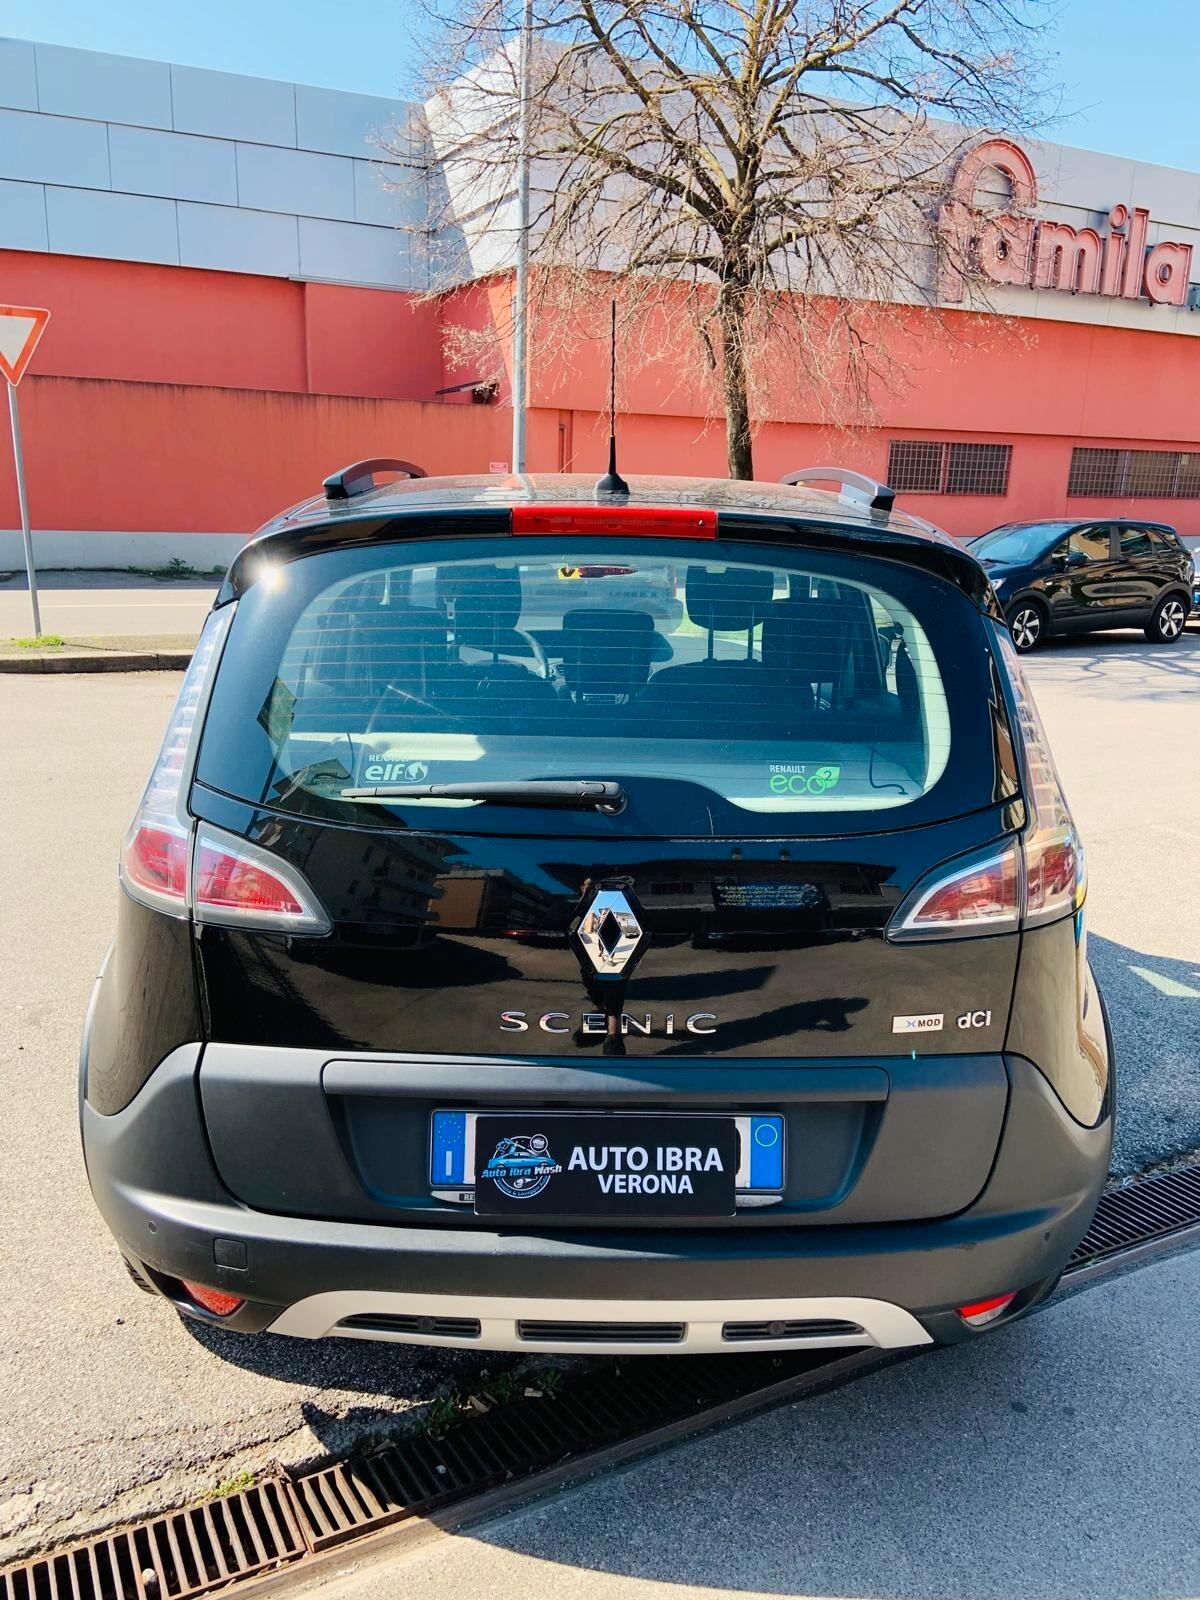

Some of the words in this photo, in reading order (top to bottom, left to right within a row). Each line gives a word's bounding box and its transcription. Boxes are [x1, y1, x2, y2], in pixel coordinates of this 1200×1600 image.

[365, 764, 406, 781] elf
[769, 765, 806, 773] RENAULT
[499, 1011, 717, 1034] SCENIC
[567, 1146, 649, 1172] AUTO
[656, 1147, 724, 1172] IBRA
[481, 1169, 507, 1178] Auto
[509, 1167, 531, 1176] Ibra
[534, 1165, 563, 1175] Wash
[598, 1174, 694, 1194] VERONA
